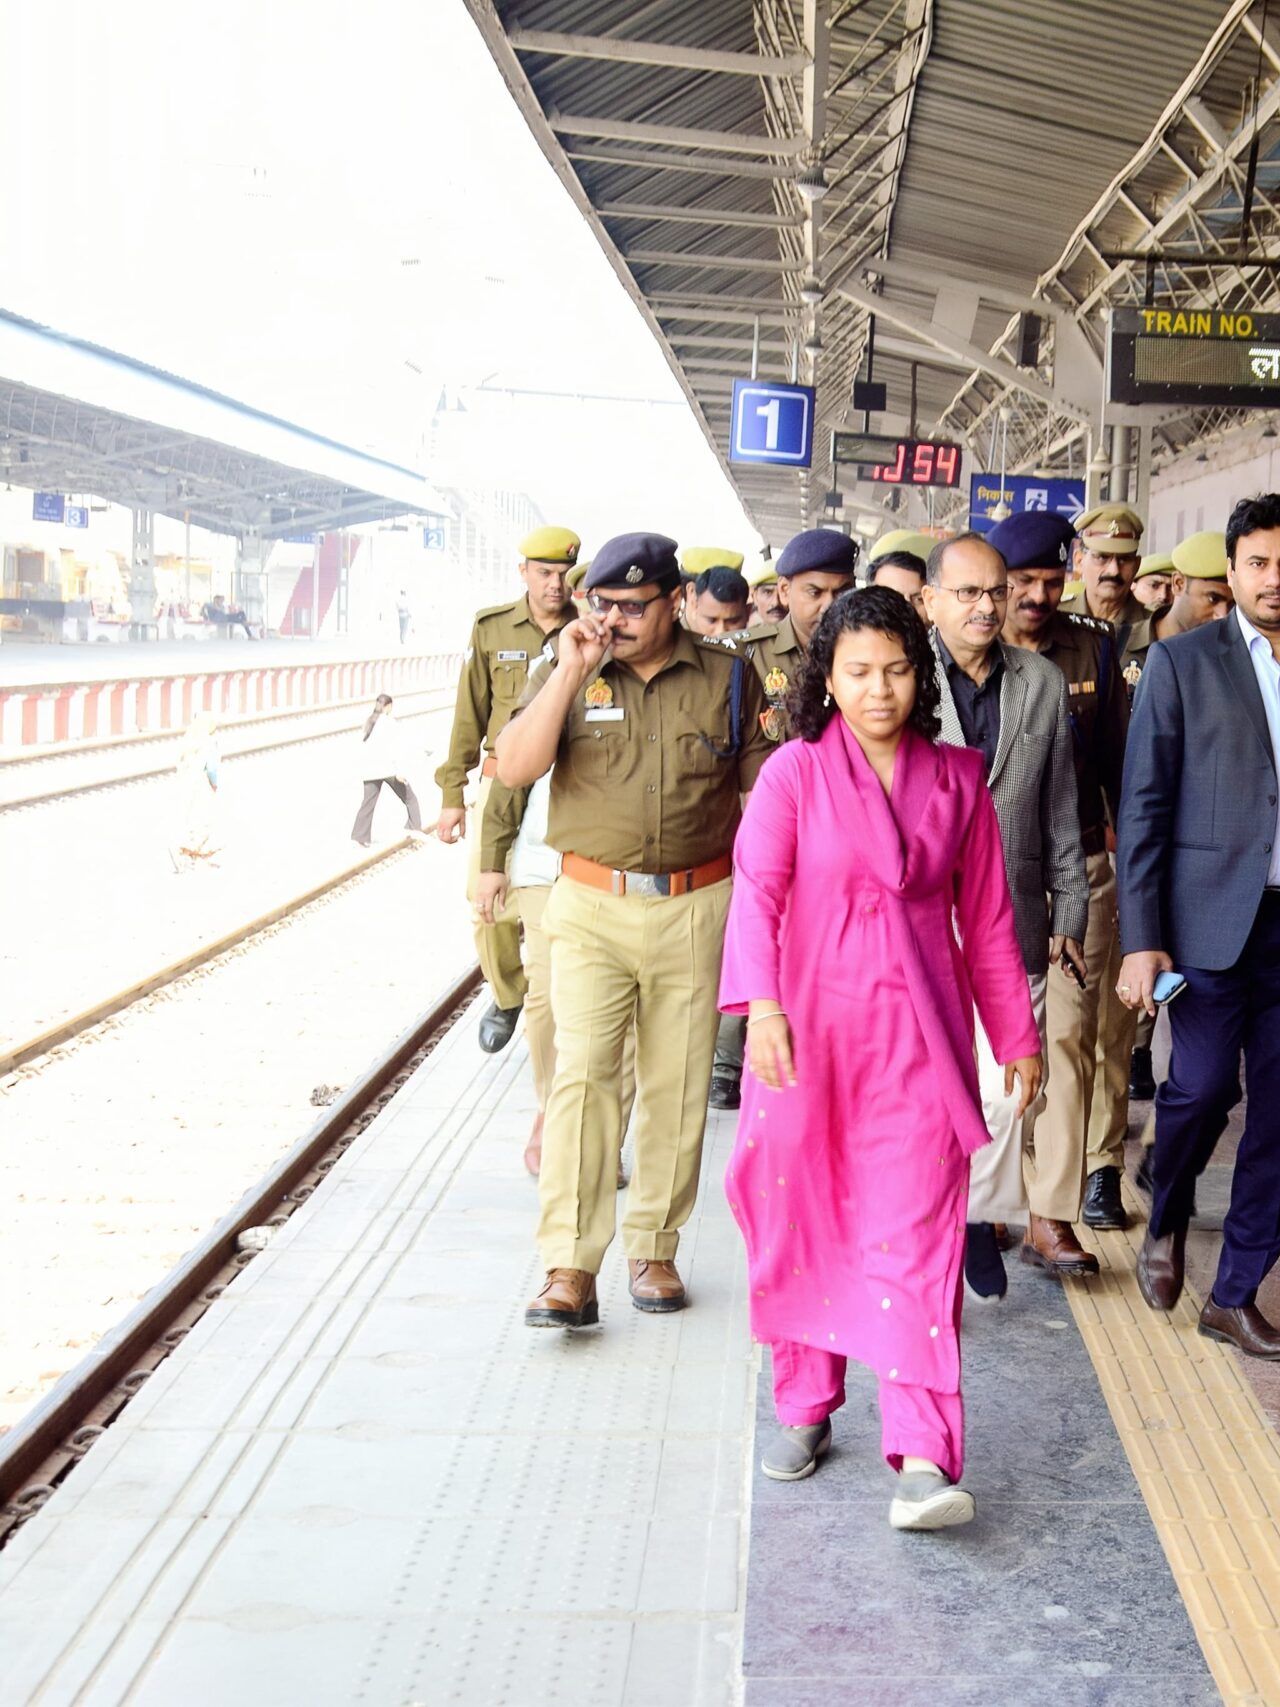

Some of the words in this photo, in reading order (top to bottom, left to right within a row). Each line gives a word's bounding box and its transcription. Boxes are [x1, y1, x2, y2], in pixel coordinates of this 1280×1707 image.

[1142, 310, 1211, 334] TRAIN
[1220, 315, 1259, 337] NO.
[756, 398, 780, 450] 1
[976, 485, 1015, 502] निकस
